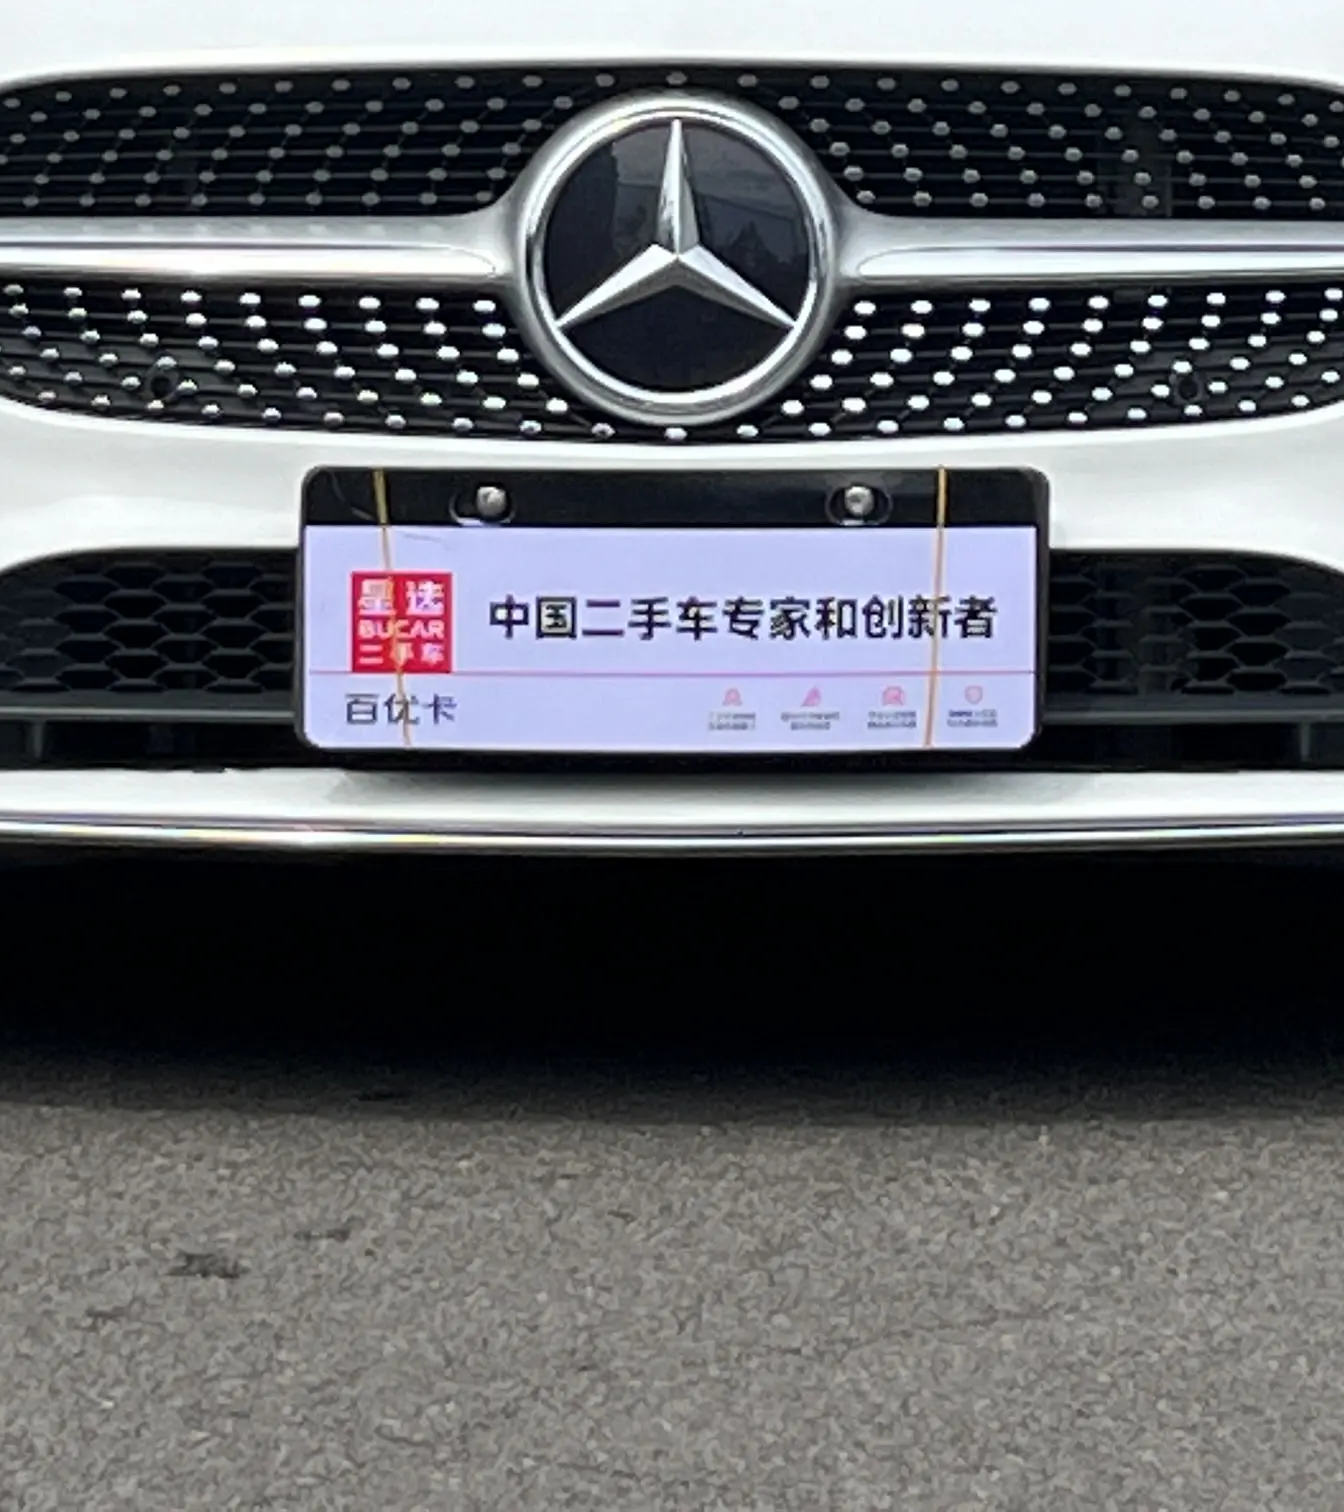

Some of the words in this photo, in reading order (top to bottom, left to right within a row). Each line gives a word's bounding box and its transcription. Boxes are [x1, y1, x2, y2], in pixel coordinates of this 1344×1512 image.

[358, 619, 444, 638] BUCAR
[488, 595, 998, 642] 中国二手车专家和创新者
[345, 693, 457, 725] 百优卡
